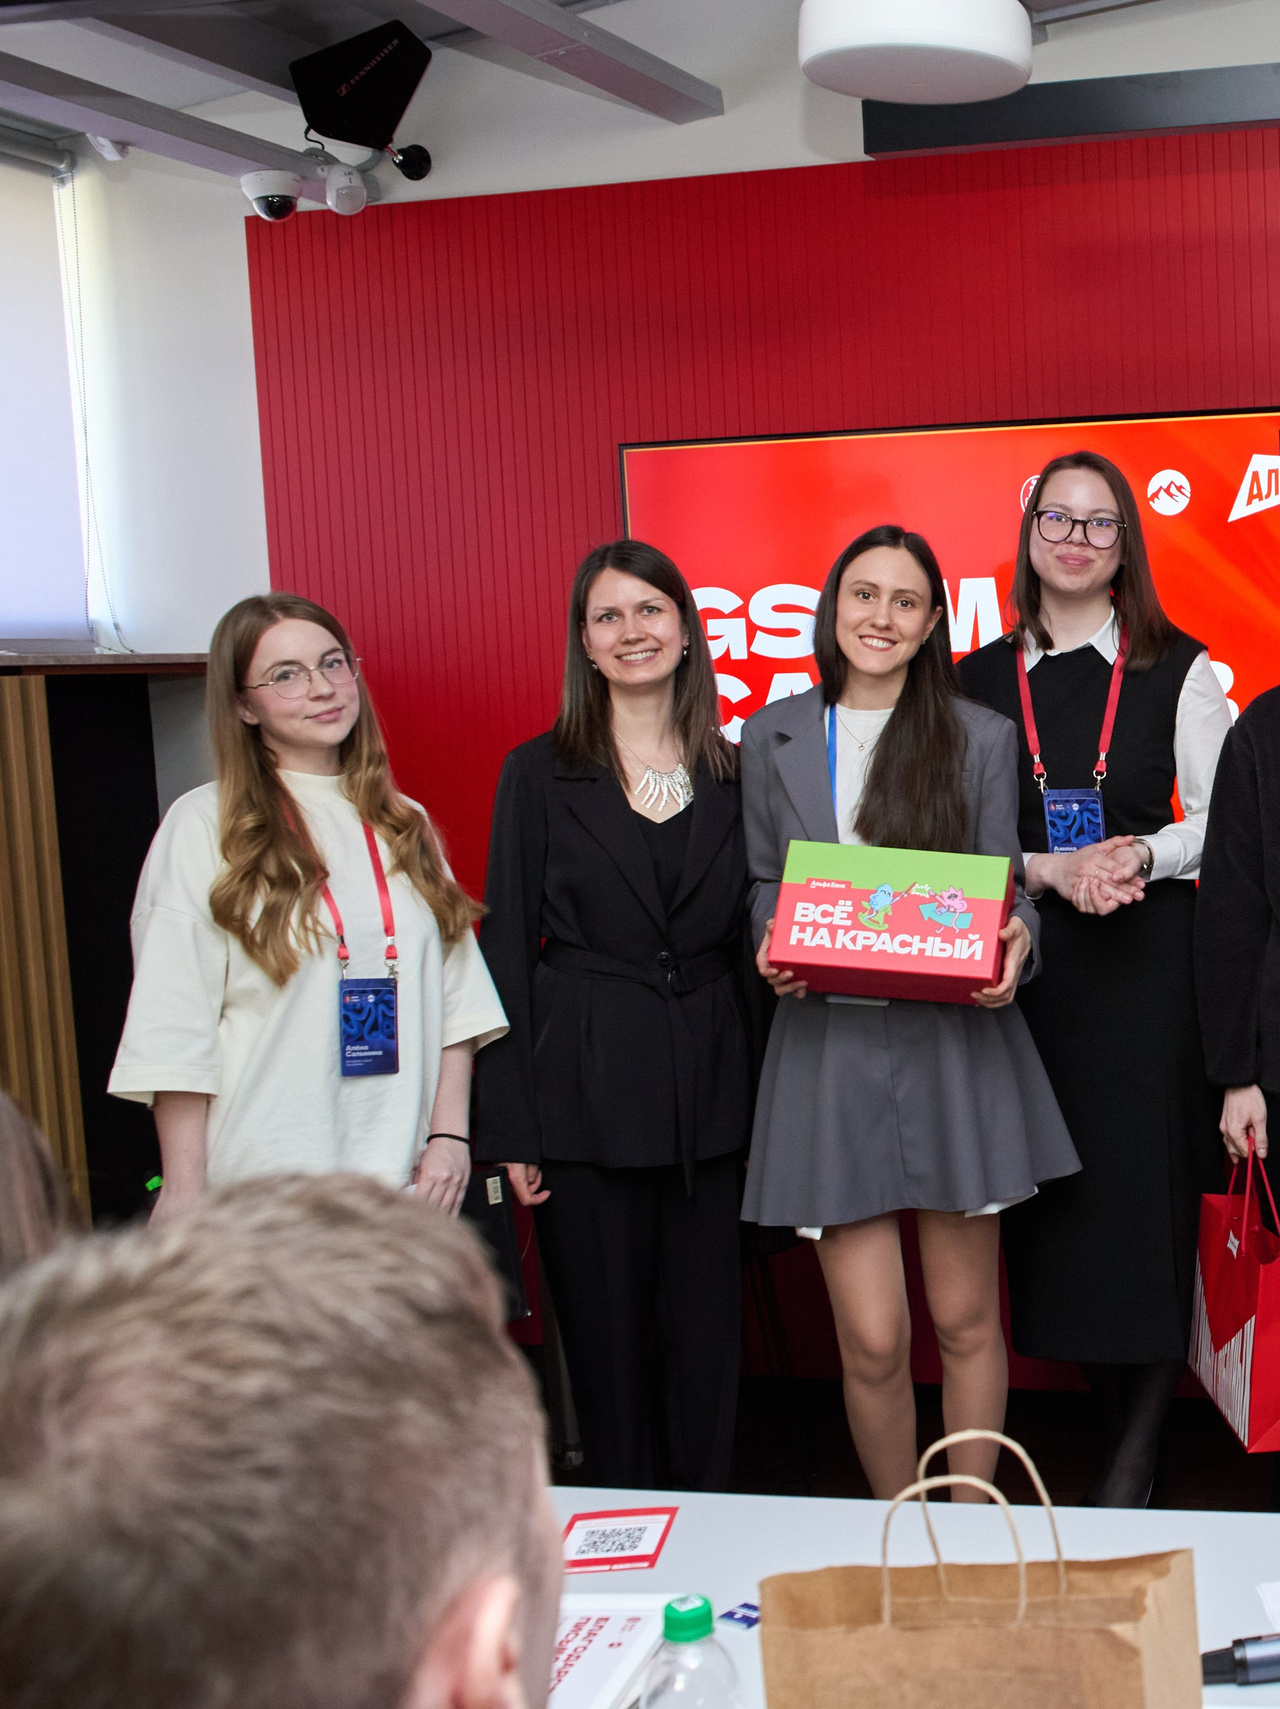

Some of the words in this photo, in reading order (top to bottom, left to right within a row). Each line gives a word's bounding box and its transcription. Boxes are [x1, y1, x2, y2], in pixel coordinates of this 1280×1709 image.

[691, 577, 1003, 660] GSM
[793, 900, 853, 926] ВСЁ
[789, 925, 832, 949] НА
[835, 929, 984, 961] КРАСНЫЙ
